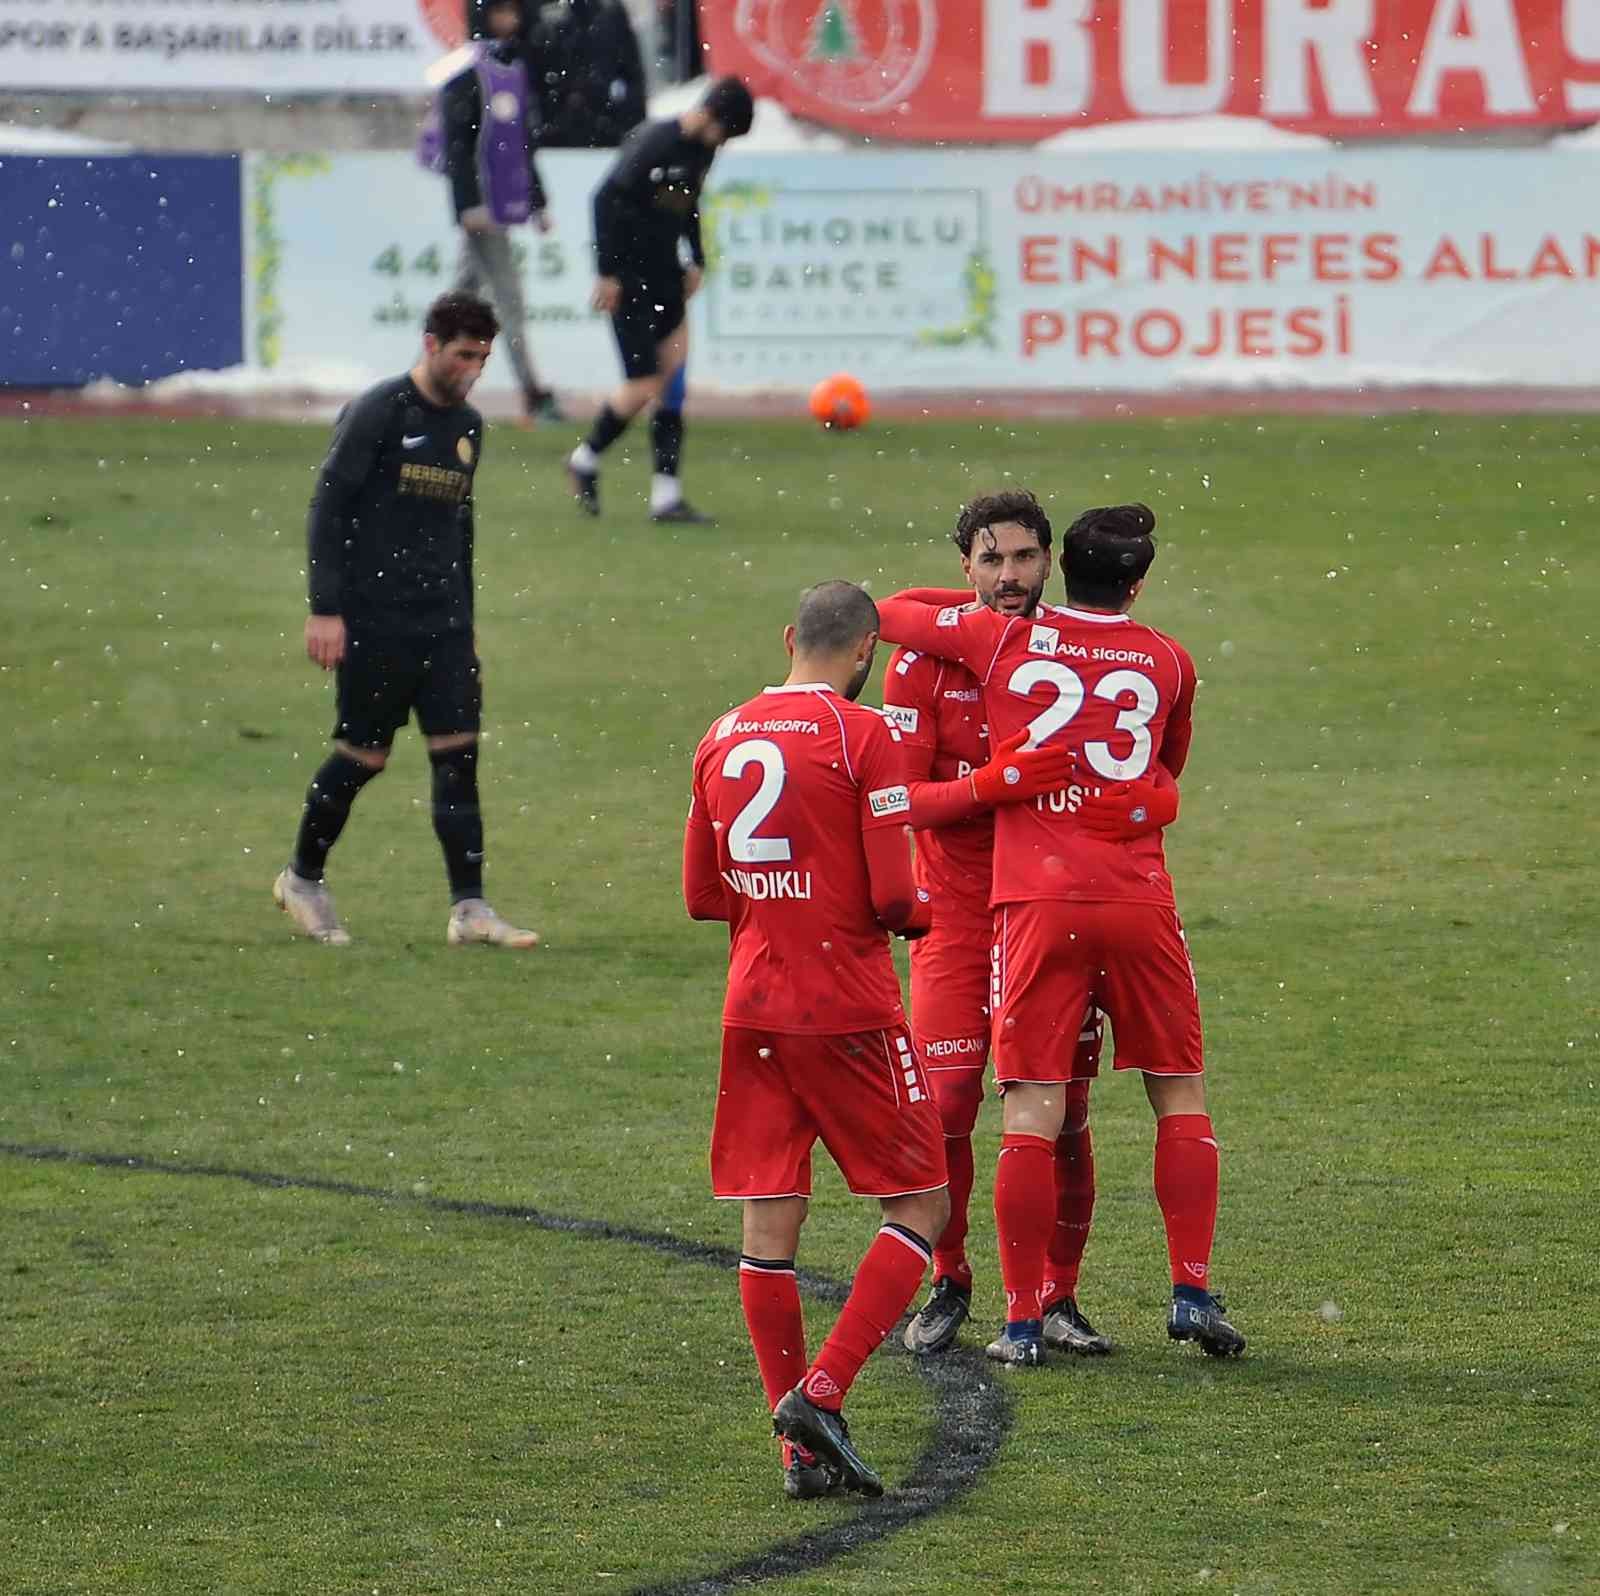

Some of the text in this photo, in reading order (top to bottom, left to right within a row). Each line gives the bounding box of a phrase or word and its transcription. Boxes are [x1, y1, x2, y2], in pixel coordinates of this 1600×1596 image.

[1020, 233, 1600, 282] EN NEFES ALA
[1022, 293, 1352, 357] PROJESİ
[1056, 642, 1088, 659] AXA
[1007, 660, 1160, 781] 23
[722, 738, 792, 863] 2
